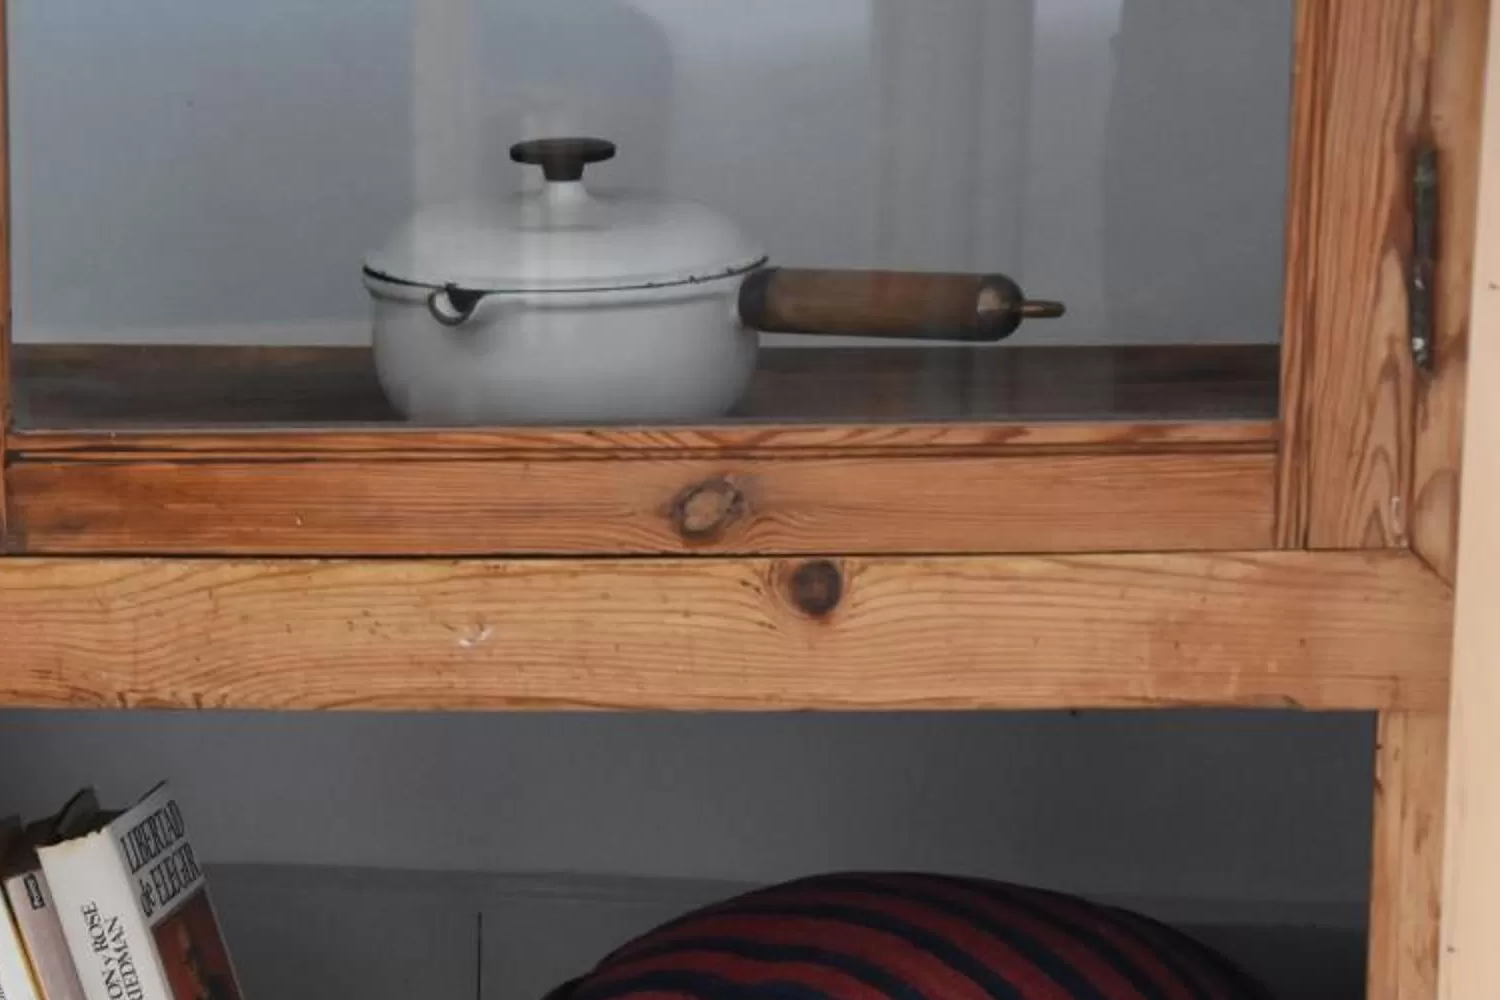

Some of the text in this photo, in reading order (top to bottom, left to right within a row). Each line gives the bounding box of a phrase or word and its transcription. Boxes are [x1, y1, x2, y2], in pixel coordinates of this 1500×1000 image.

[120, 799, 184, 875] LIBERTAD
[139, 841, 201, 918] de ELEGIR
[82, 902, 108, 952] ROSE
[102, 954, 115, 966] y
